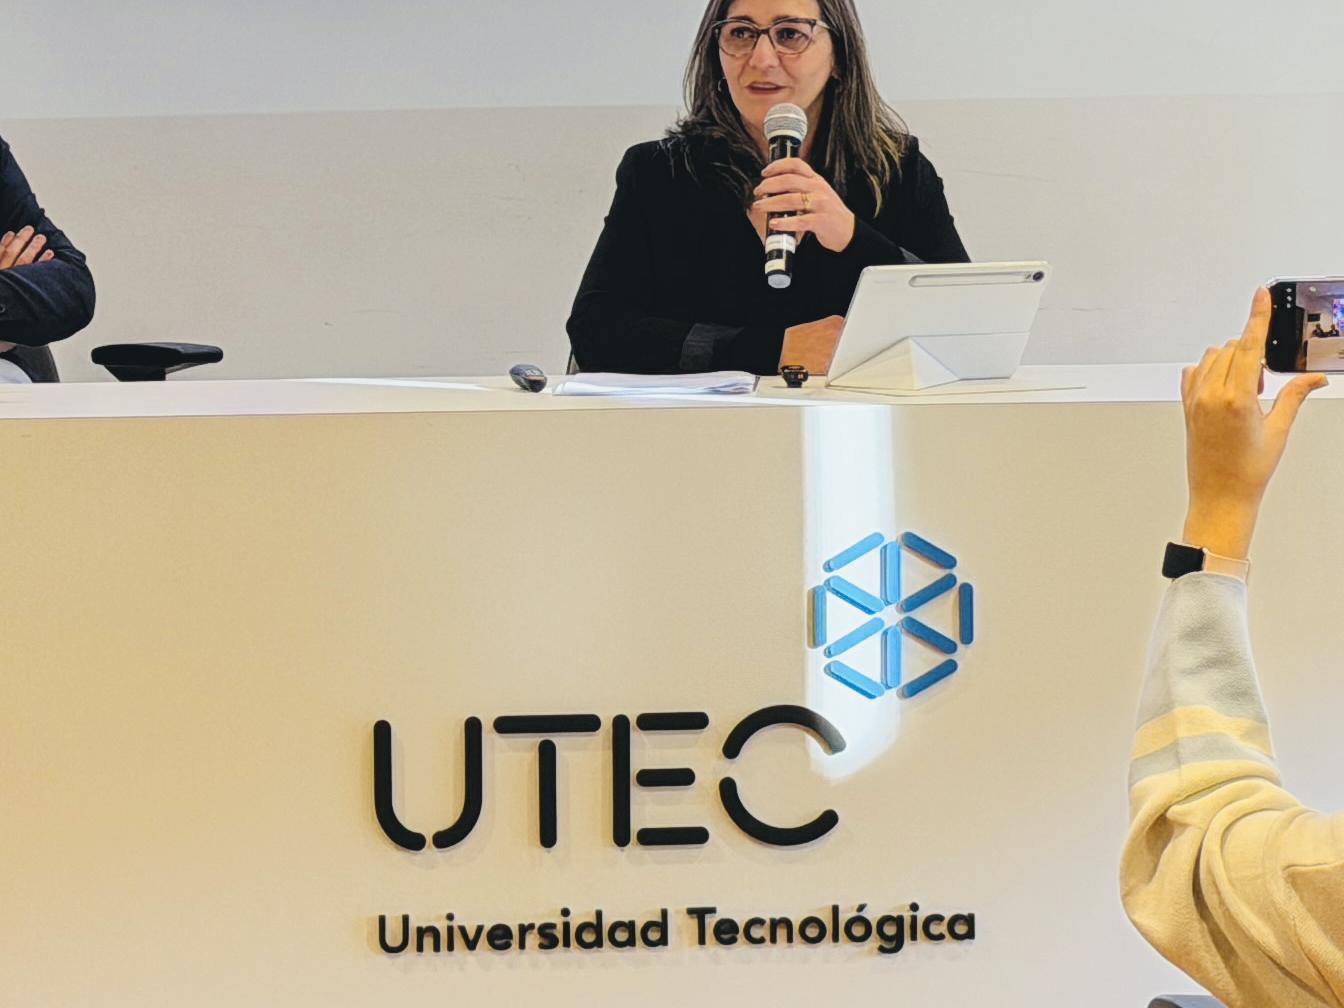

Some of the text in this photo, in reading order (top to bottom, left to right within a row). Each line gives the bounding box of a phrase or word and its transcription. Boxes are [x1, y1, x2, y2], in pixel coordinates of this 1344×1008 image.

[374, 705, 846, 851] UTEC
[378, 903, 976, 955] Universidad Tecnológica
